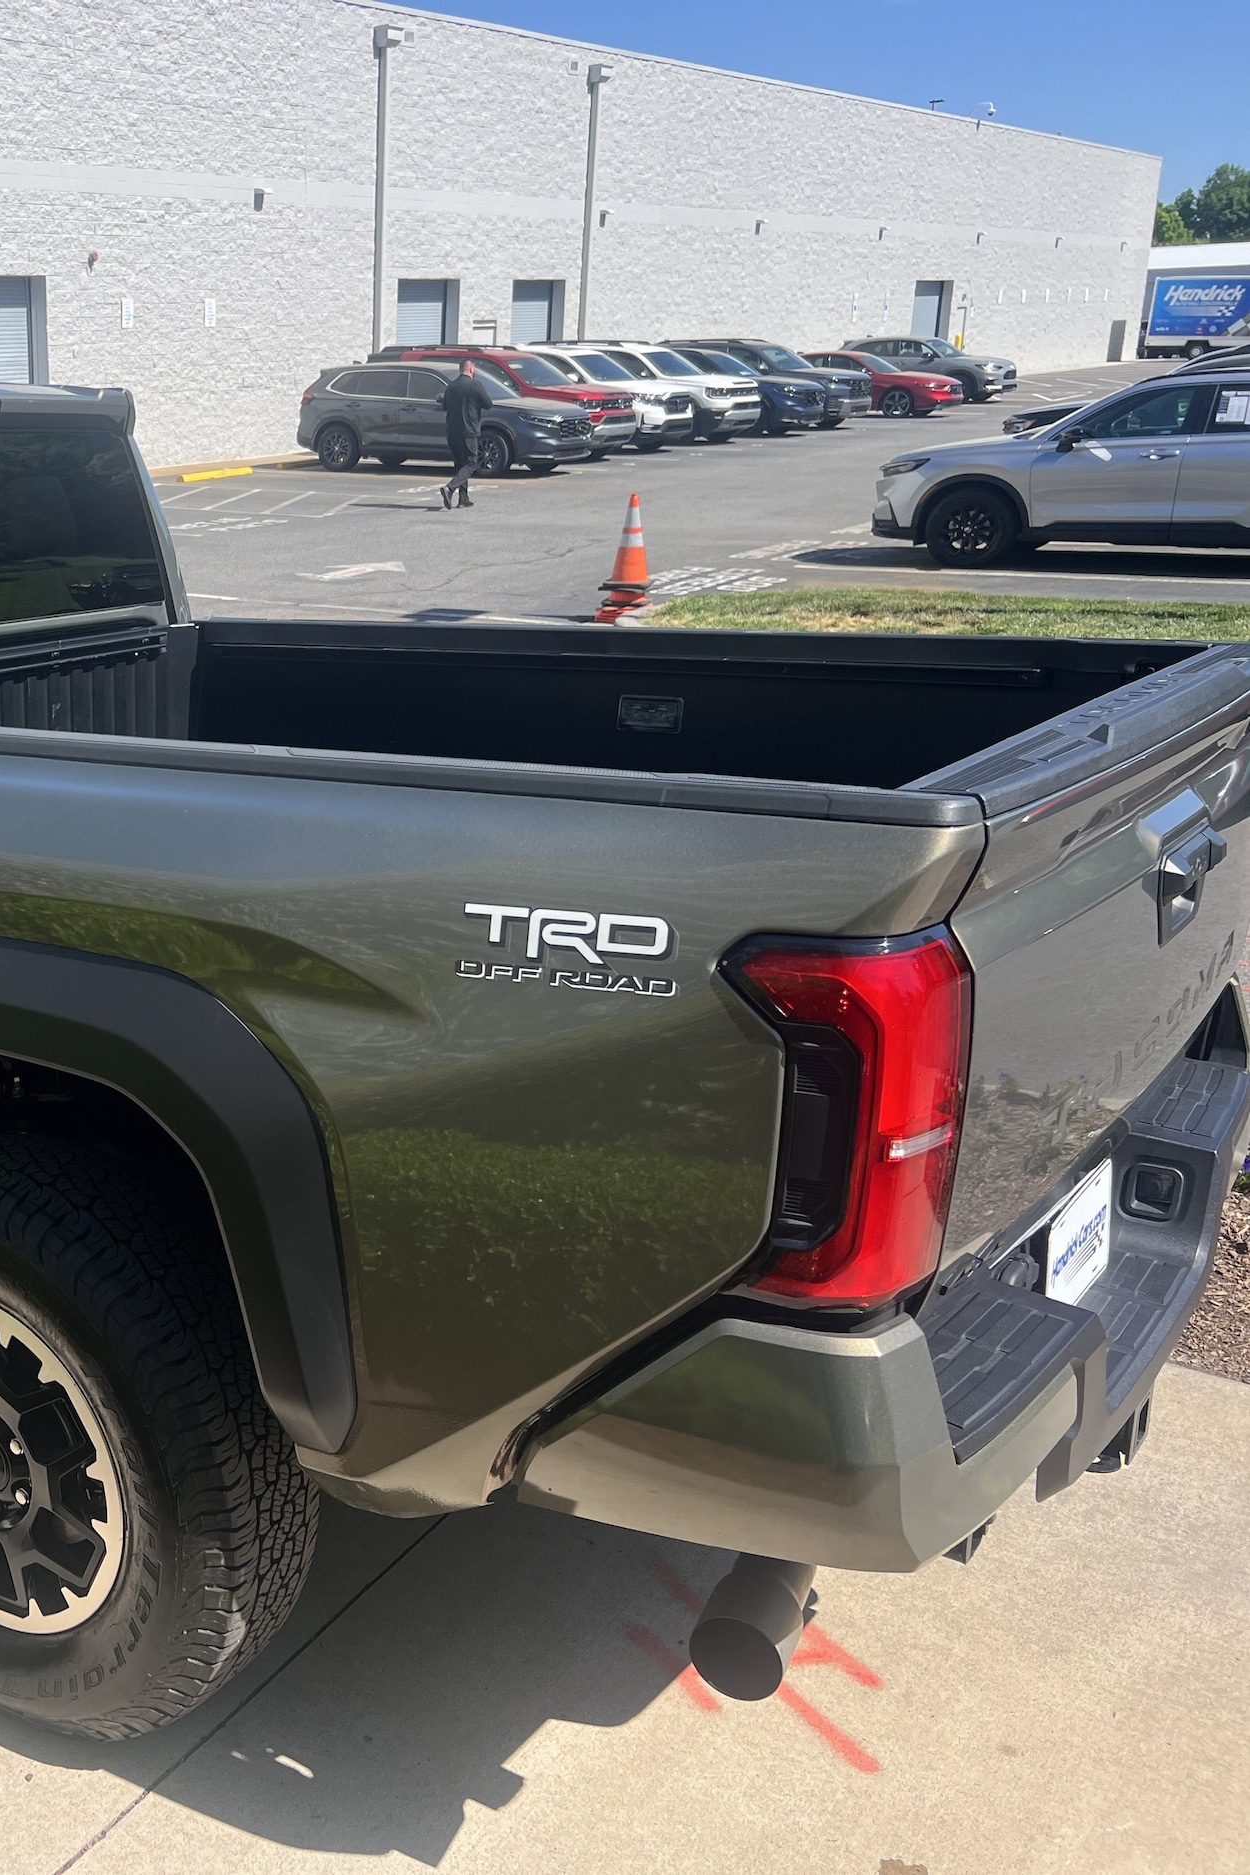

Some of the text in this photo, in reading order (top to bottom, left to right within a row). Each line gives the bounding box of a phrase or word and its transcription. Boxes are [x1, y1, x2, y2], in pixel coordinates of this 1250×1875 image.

[1163, 284, 1247, 306] Hendrick
[464, 902, 672, 966] TRD
[454, 959, 677, 997] OFF ROAD
